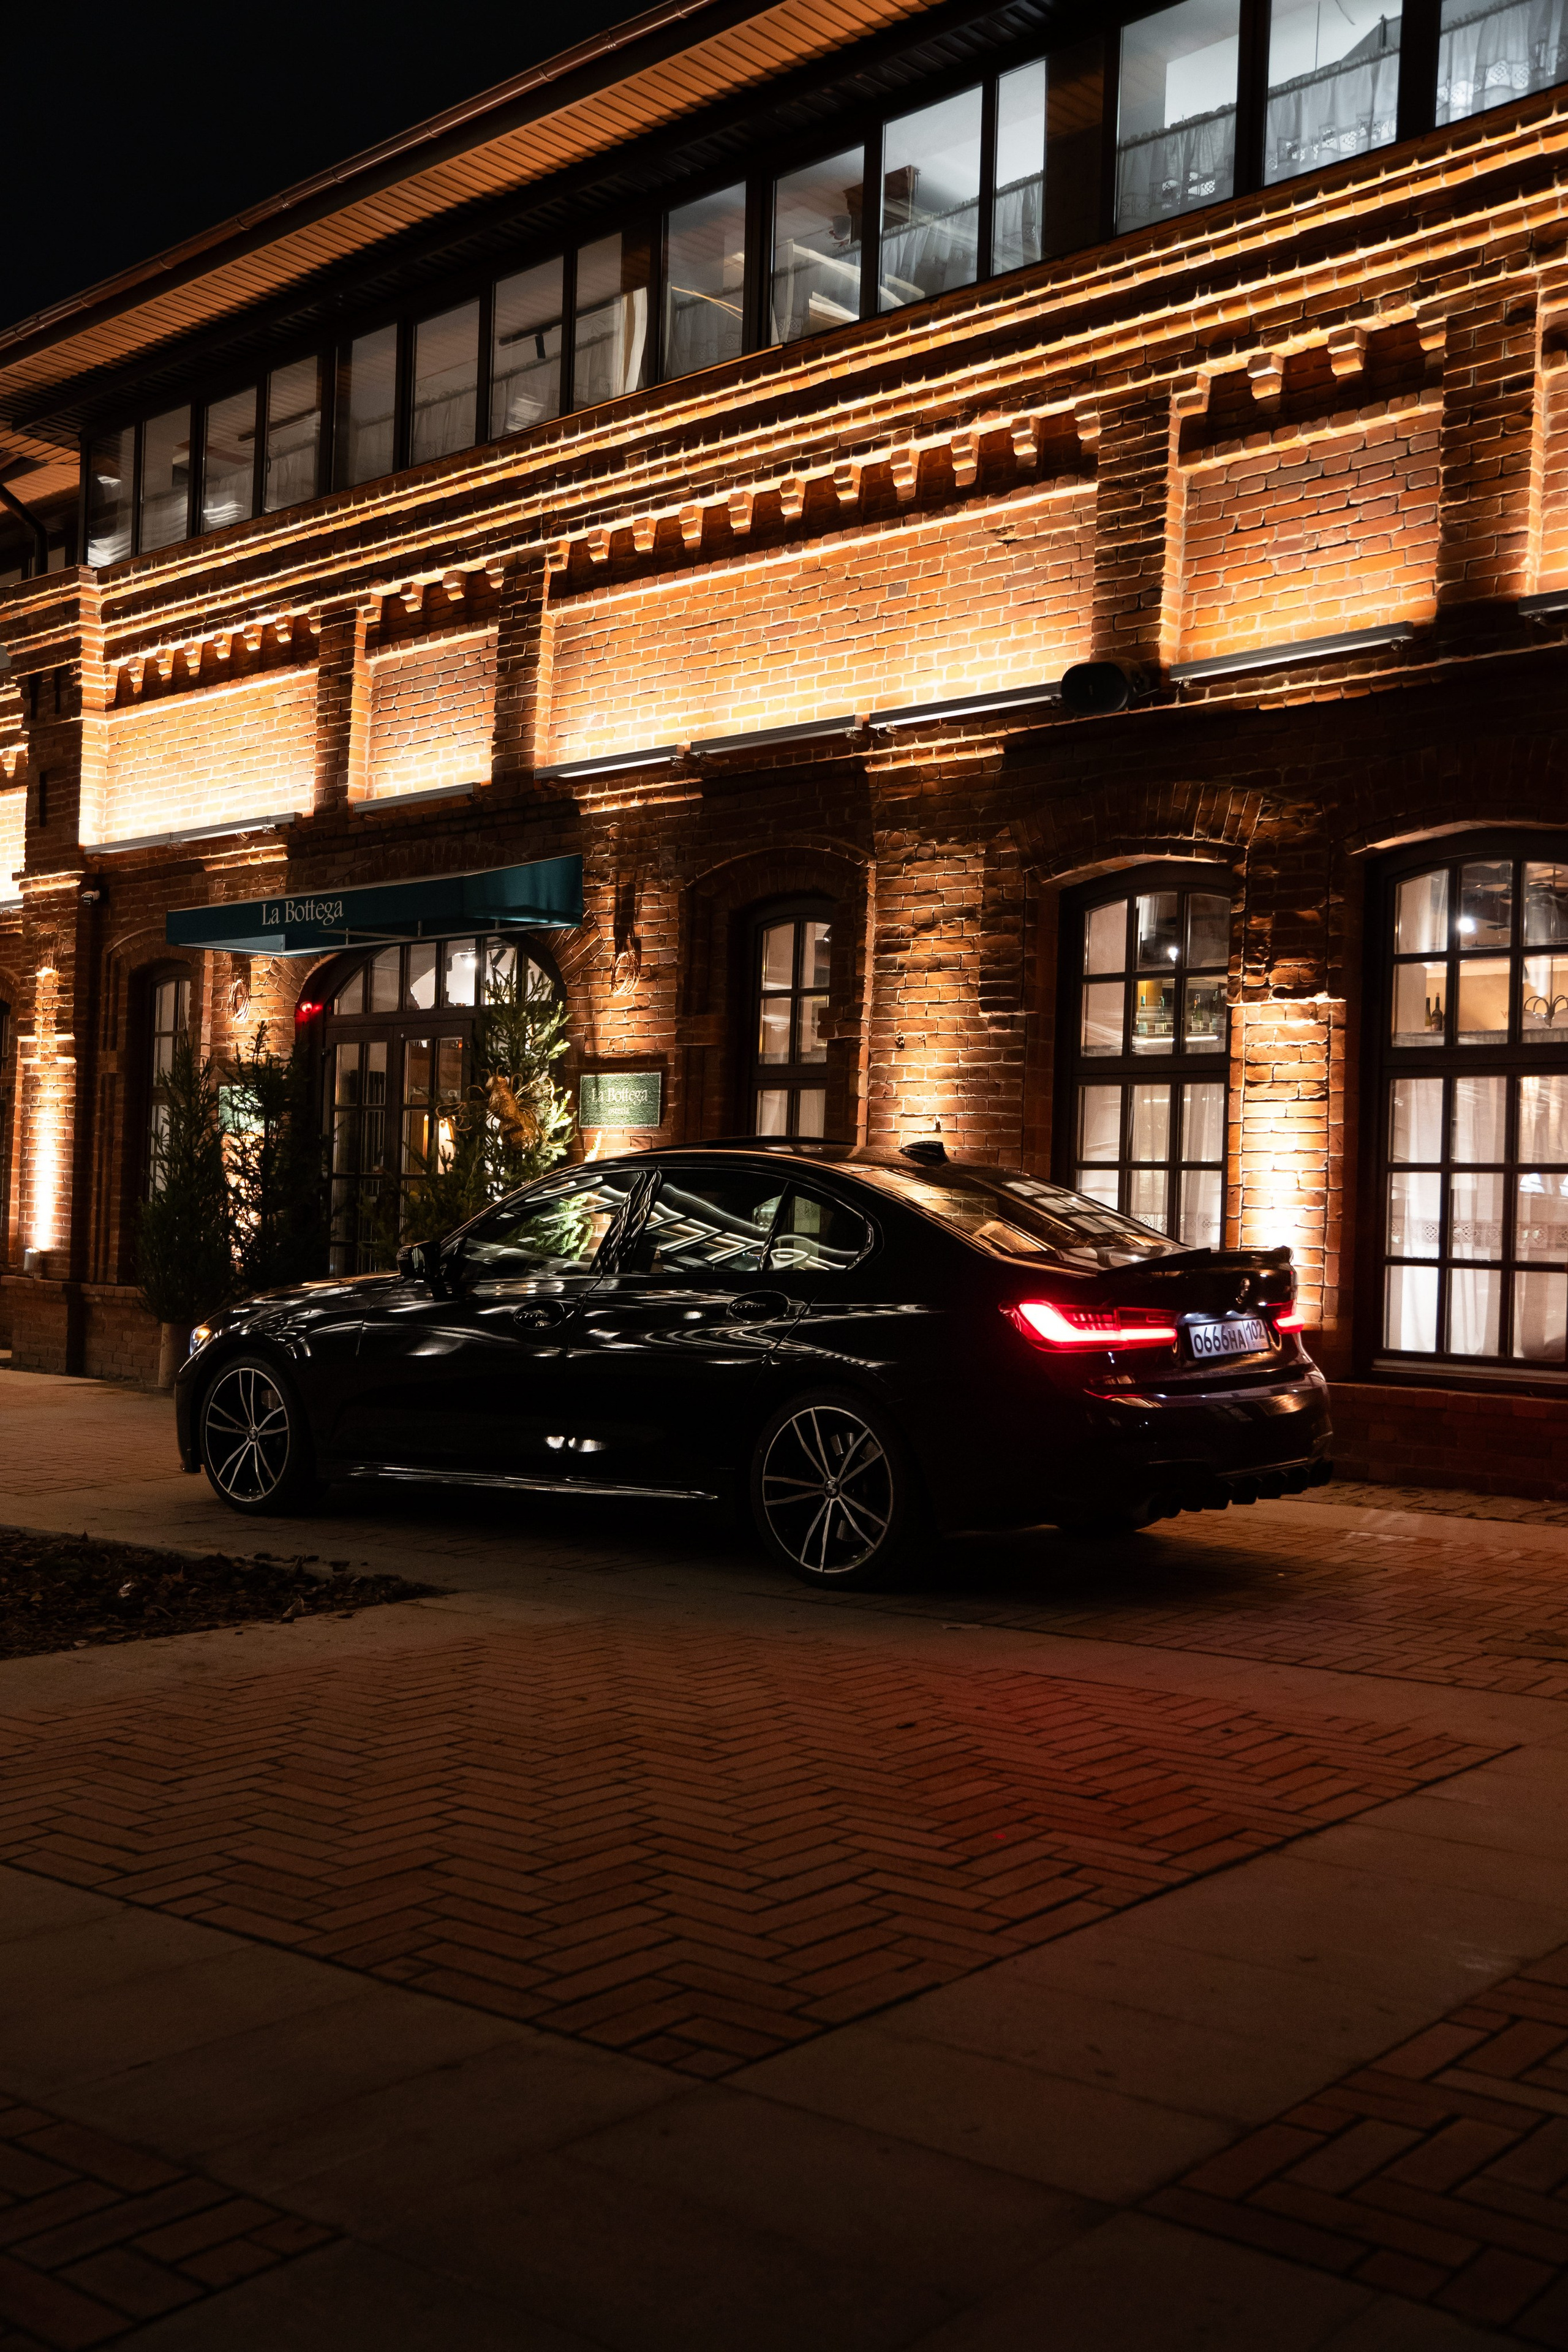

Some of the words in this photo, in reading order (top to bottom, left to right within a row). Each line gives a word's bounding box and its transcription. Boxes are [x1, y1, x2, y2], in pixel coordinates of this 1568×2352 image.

[262, 903, 280, 925] La
[285, 899, 344, 925] Bottega
[590, 1087, 605, 1103] La
[606, 1087, 648, 1106] Bottega
[1246, 1320, 1265, 1340] 102
